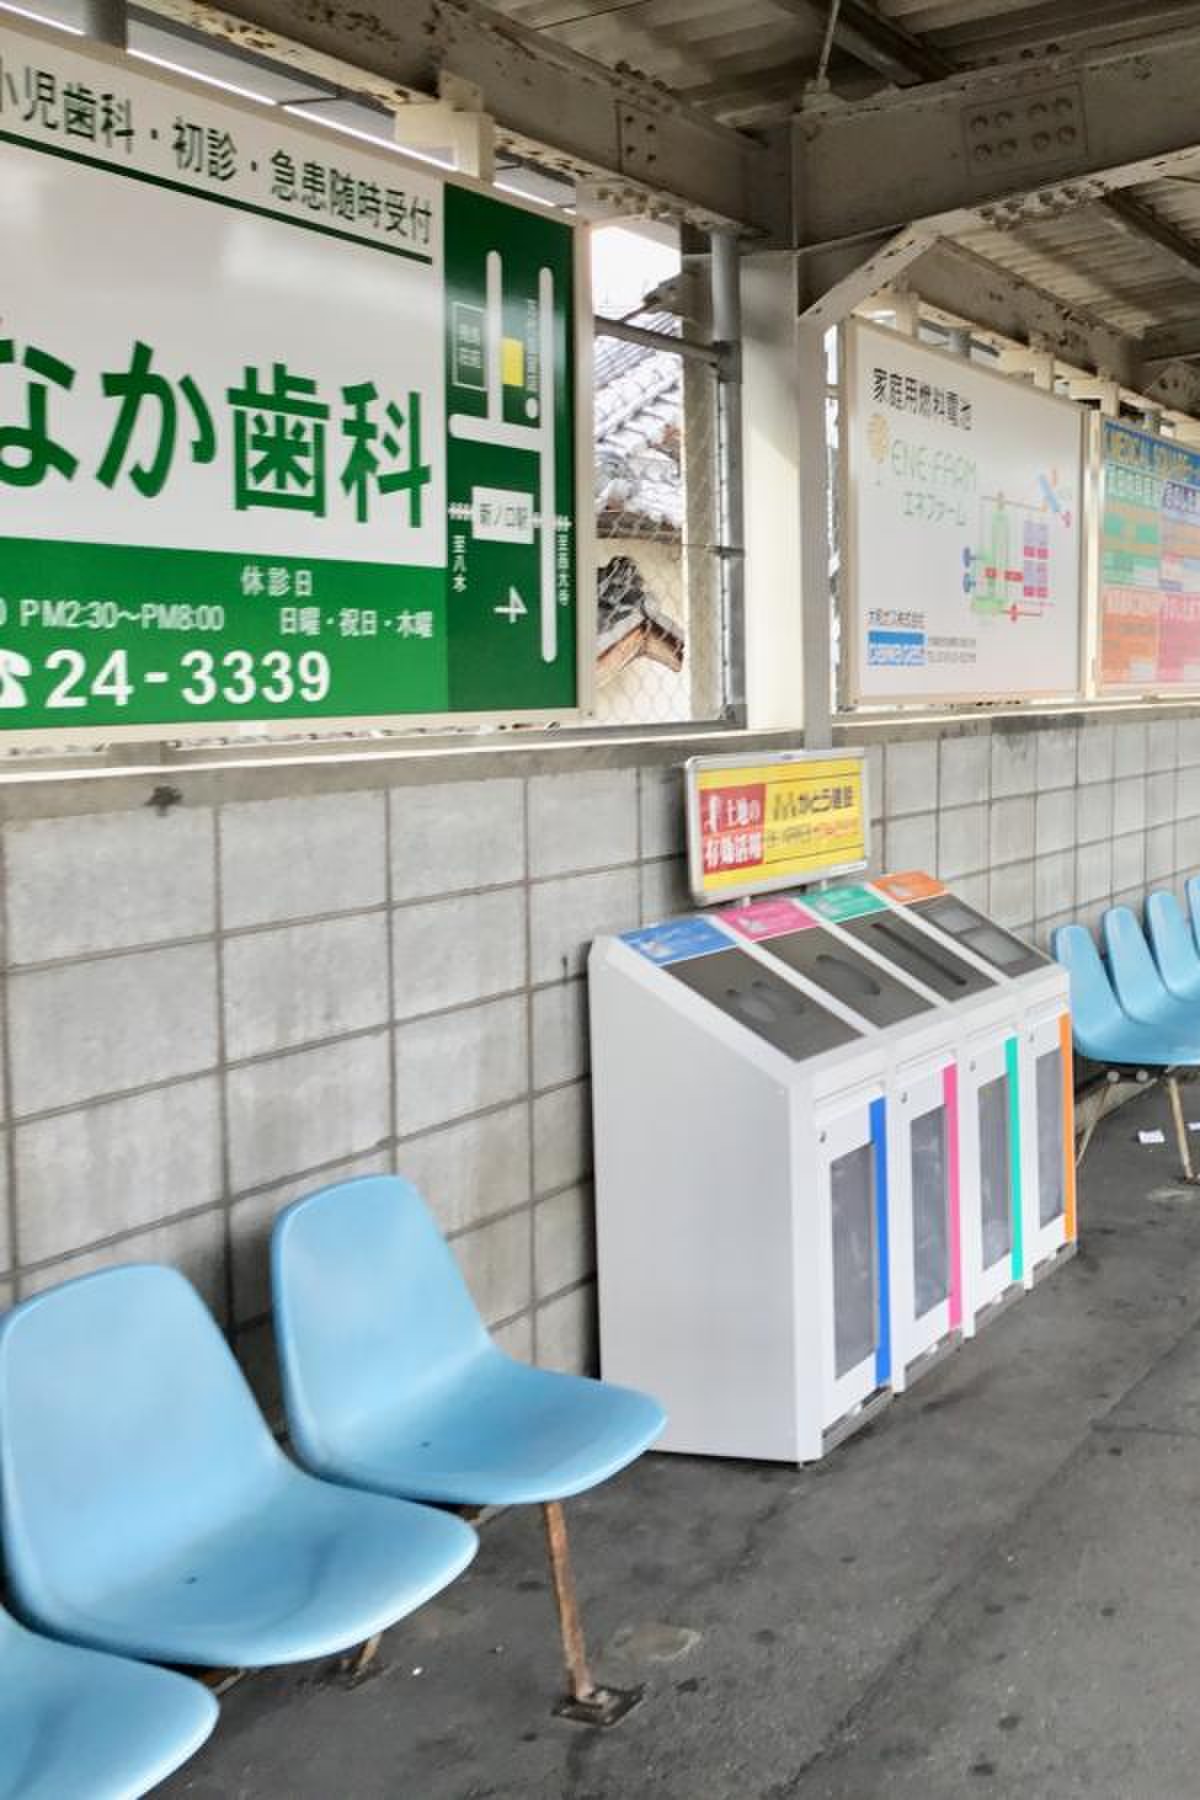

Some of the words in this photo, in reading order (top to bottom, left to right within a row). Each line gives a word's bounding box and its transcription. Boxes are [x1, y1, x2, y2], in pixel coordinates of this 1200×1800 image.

[241, 566, 313, 596] 休診日
[45, 649, 330, 708] 24-3339
